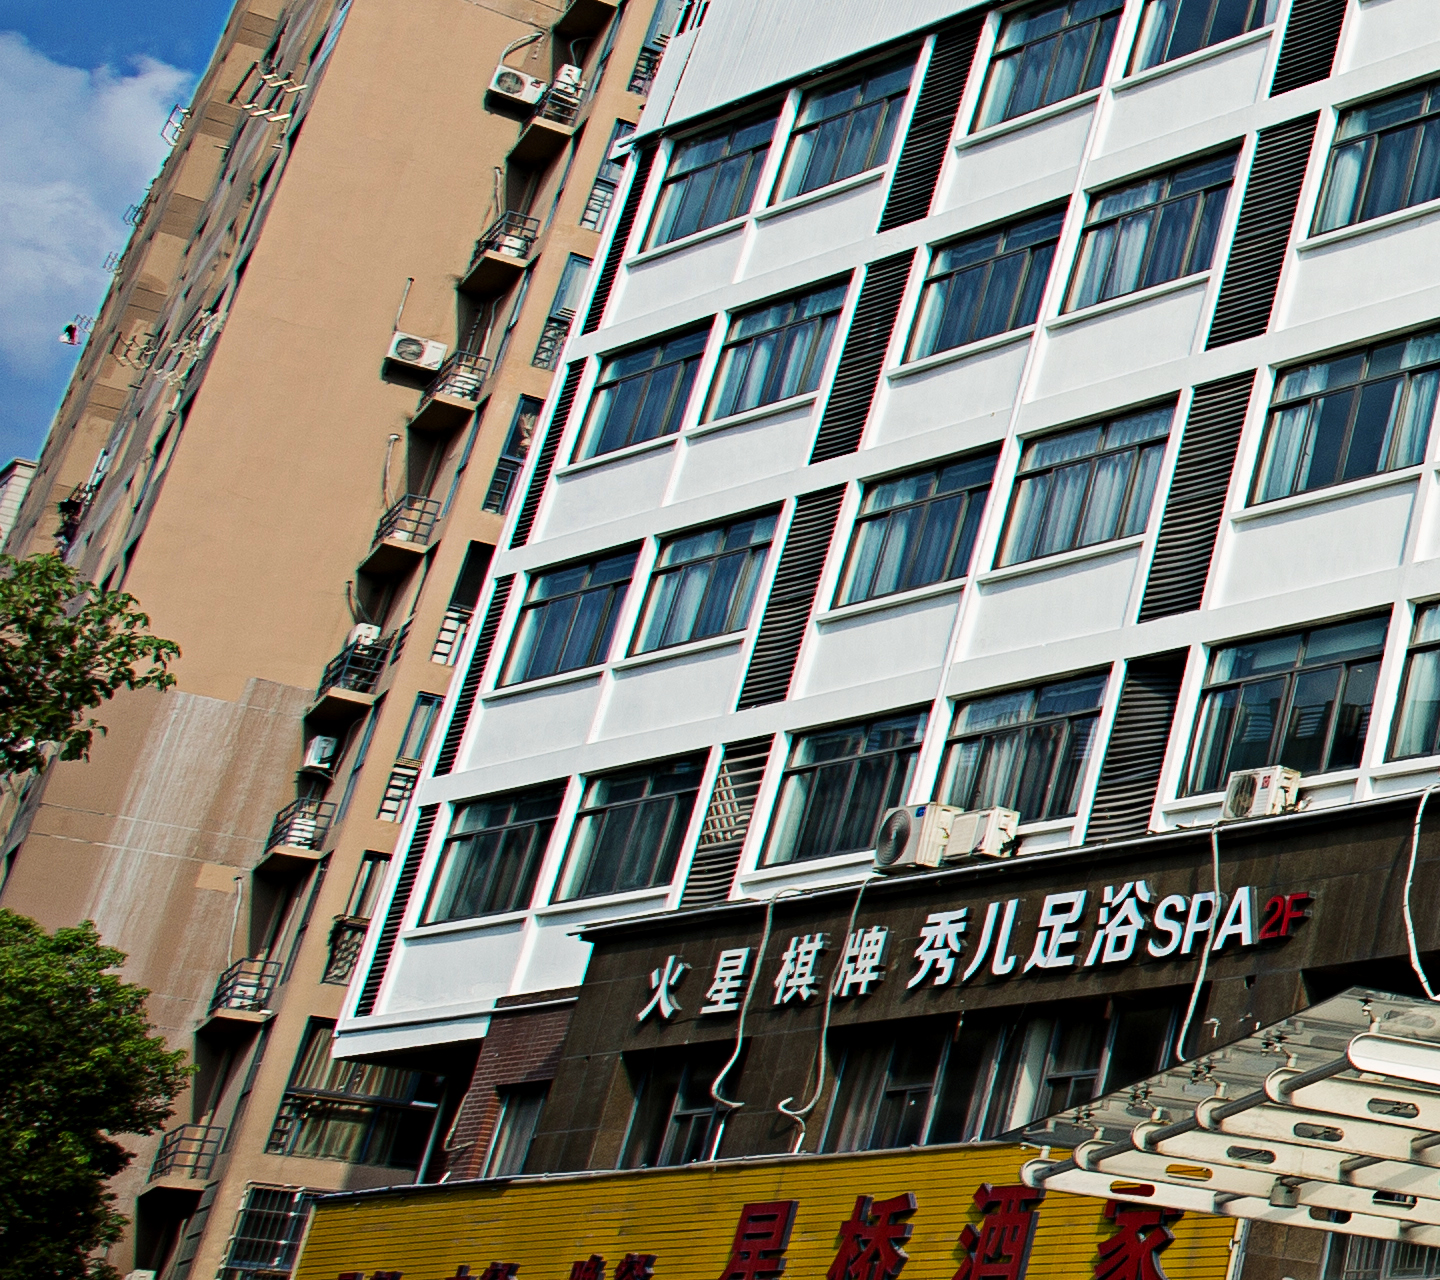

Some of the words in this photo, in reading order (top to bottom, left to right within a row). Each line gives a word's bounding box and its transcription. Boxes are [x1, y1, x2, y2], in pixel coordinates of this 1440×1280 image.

[638, 925, 888, 1021] 火星棋牌
[1260, 891, 1314, 940] 2F
